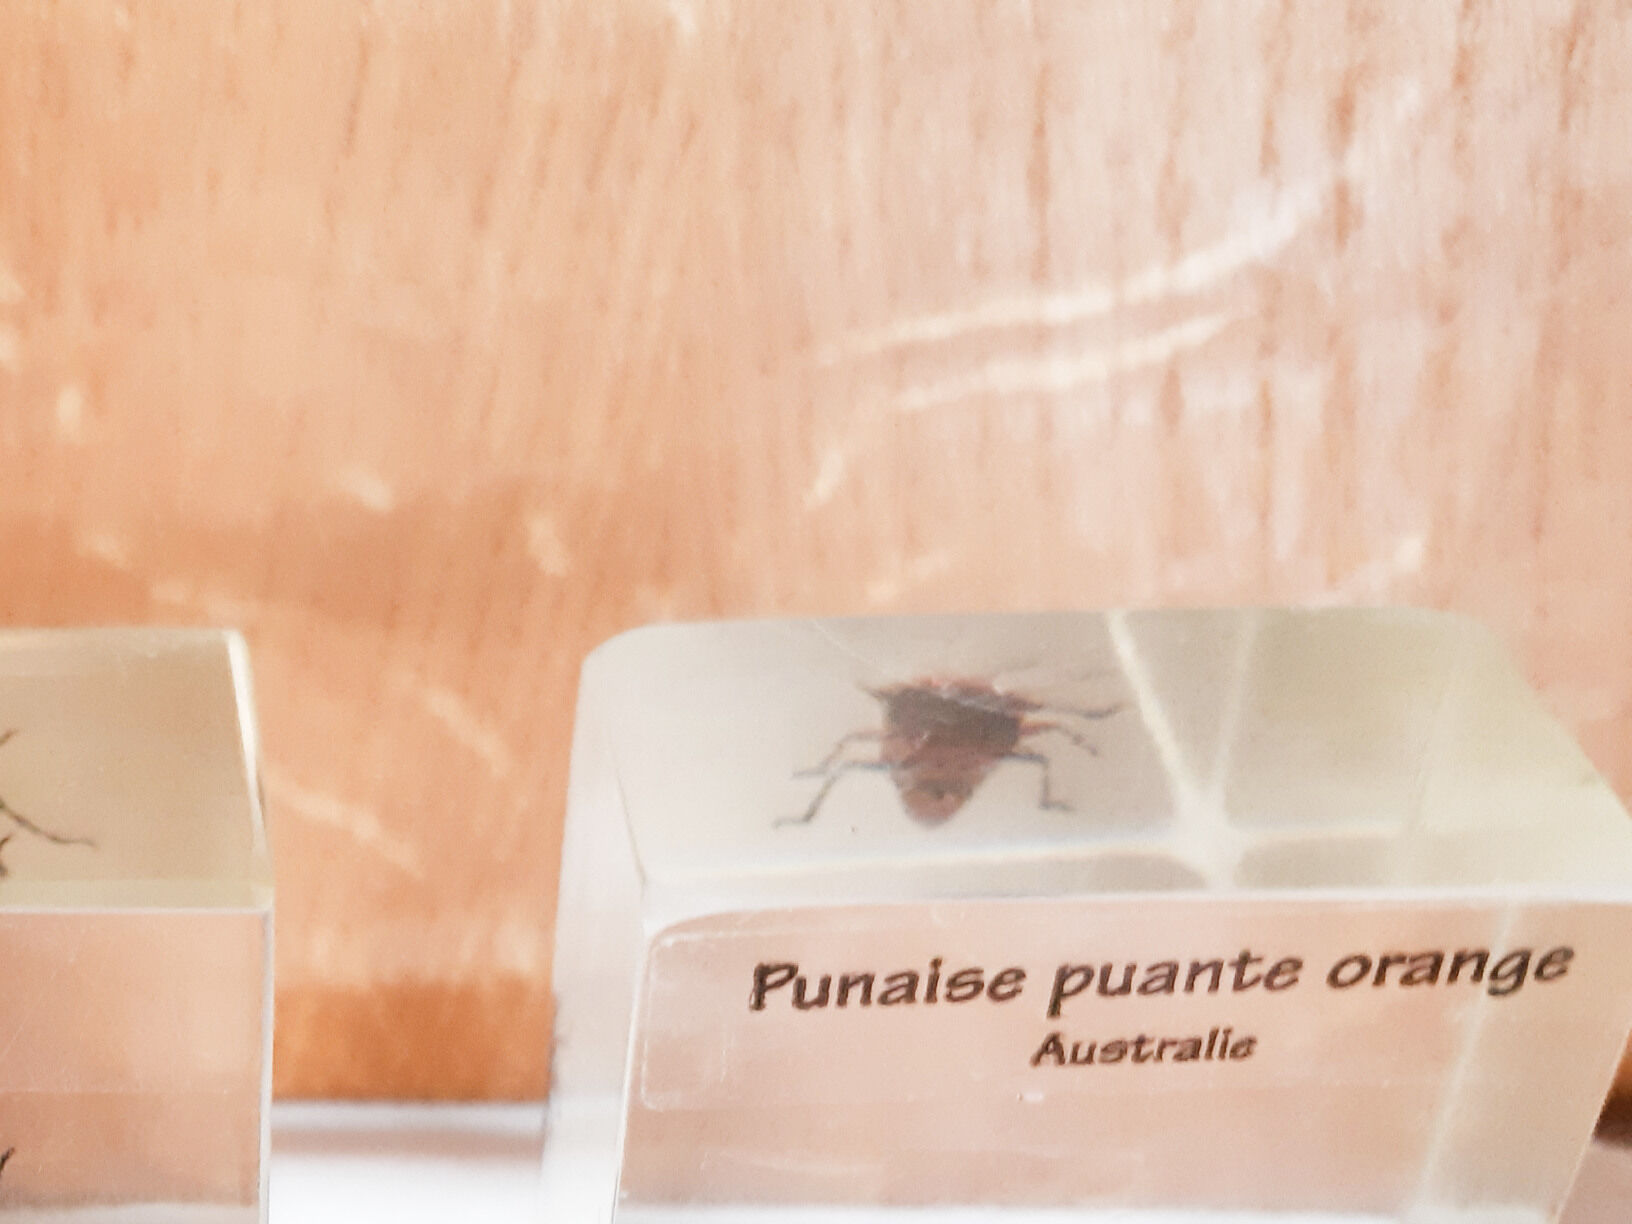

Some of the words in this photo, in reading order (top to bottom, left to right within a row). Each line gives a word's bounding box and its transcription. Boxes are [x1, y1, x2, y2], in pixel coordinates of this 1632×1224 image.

[749, 956, 1027, 1012] Punaise
[1047, 947, 1304, 1018] puante
[1327, 943, 1575, 996] orange
[1031, 1026, 1258, 1067] Australie
